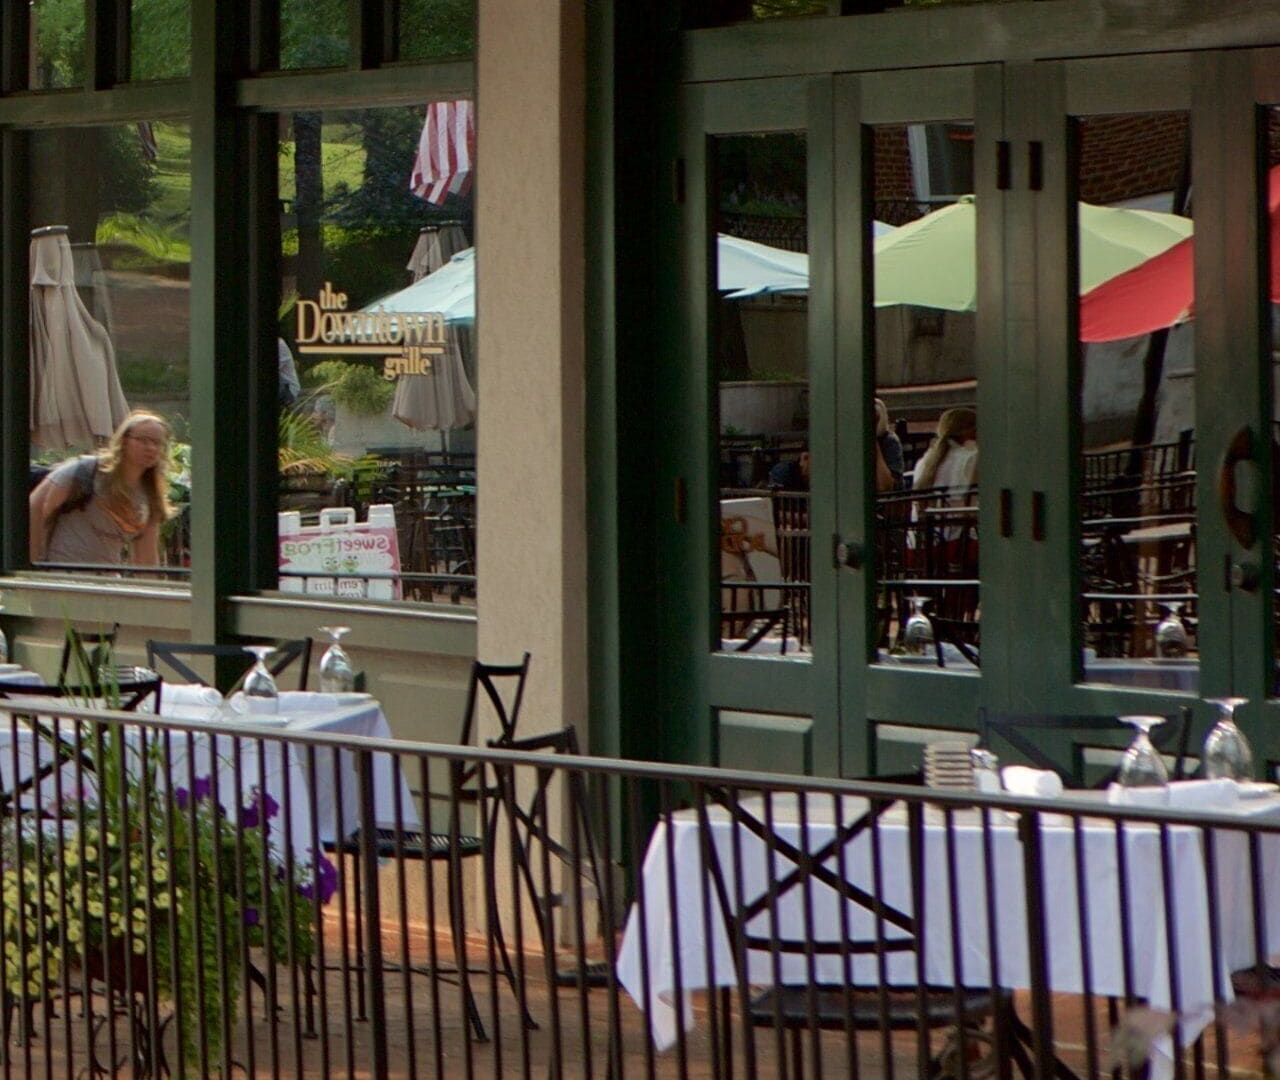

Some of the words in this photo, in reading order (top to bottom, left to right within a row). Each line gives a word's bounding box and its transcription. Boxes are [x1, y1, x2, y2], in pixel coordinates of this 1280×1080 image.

[319, 281, 348, 310] the
[295, 300, 446, 344] Downtown
[383, 346, 432, 381] grille
